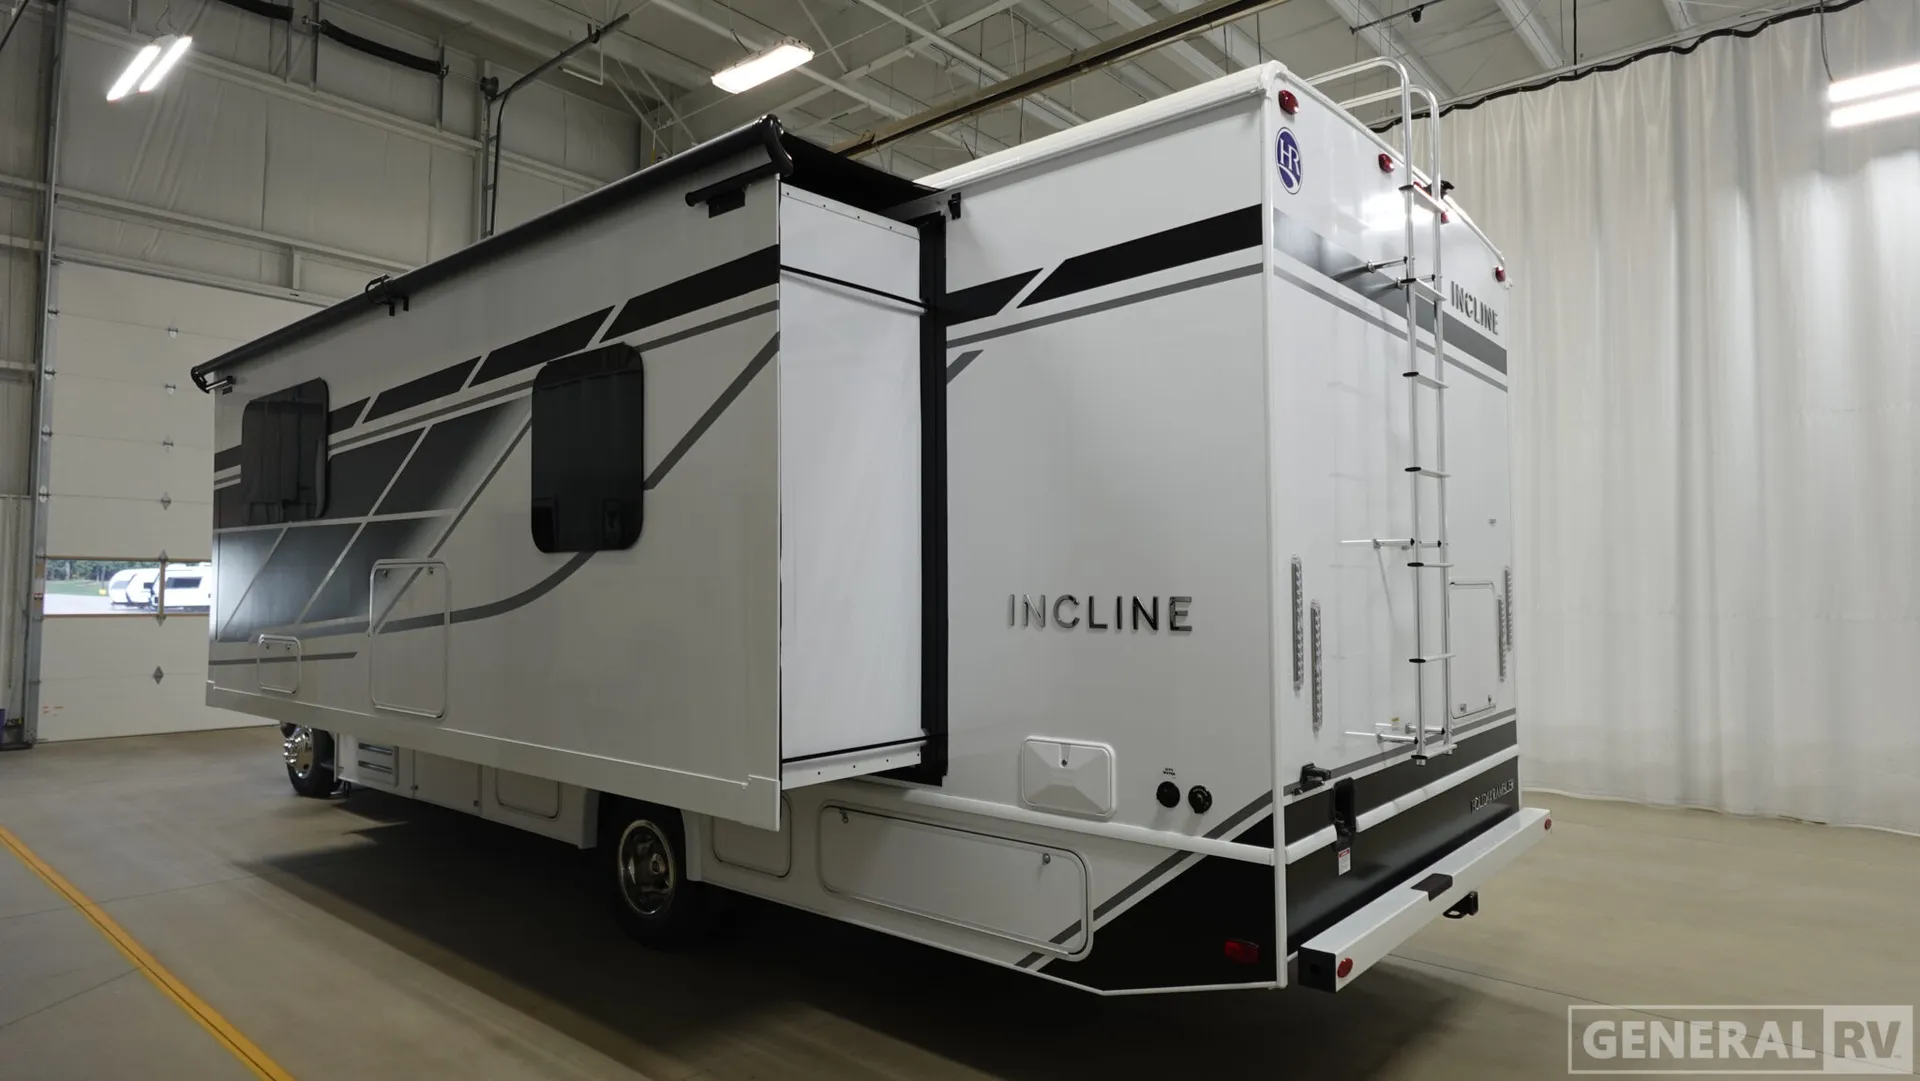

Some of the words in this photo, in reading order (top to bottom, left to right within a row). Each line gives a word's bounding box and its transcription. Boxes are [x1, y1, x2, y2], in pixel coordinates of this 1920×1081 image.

[1280, 138, 1300, 176] HR
[1451, 281, 1498, 335] INCLINE
[1007, 594, 1192, 632] INCLINE
